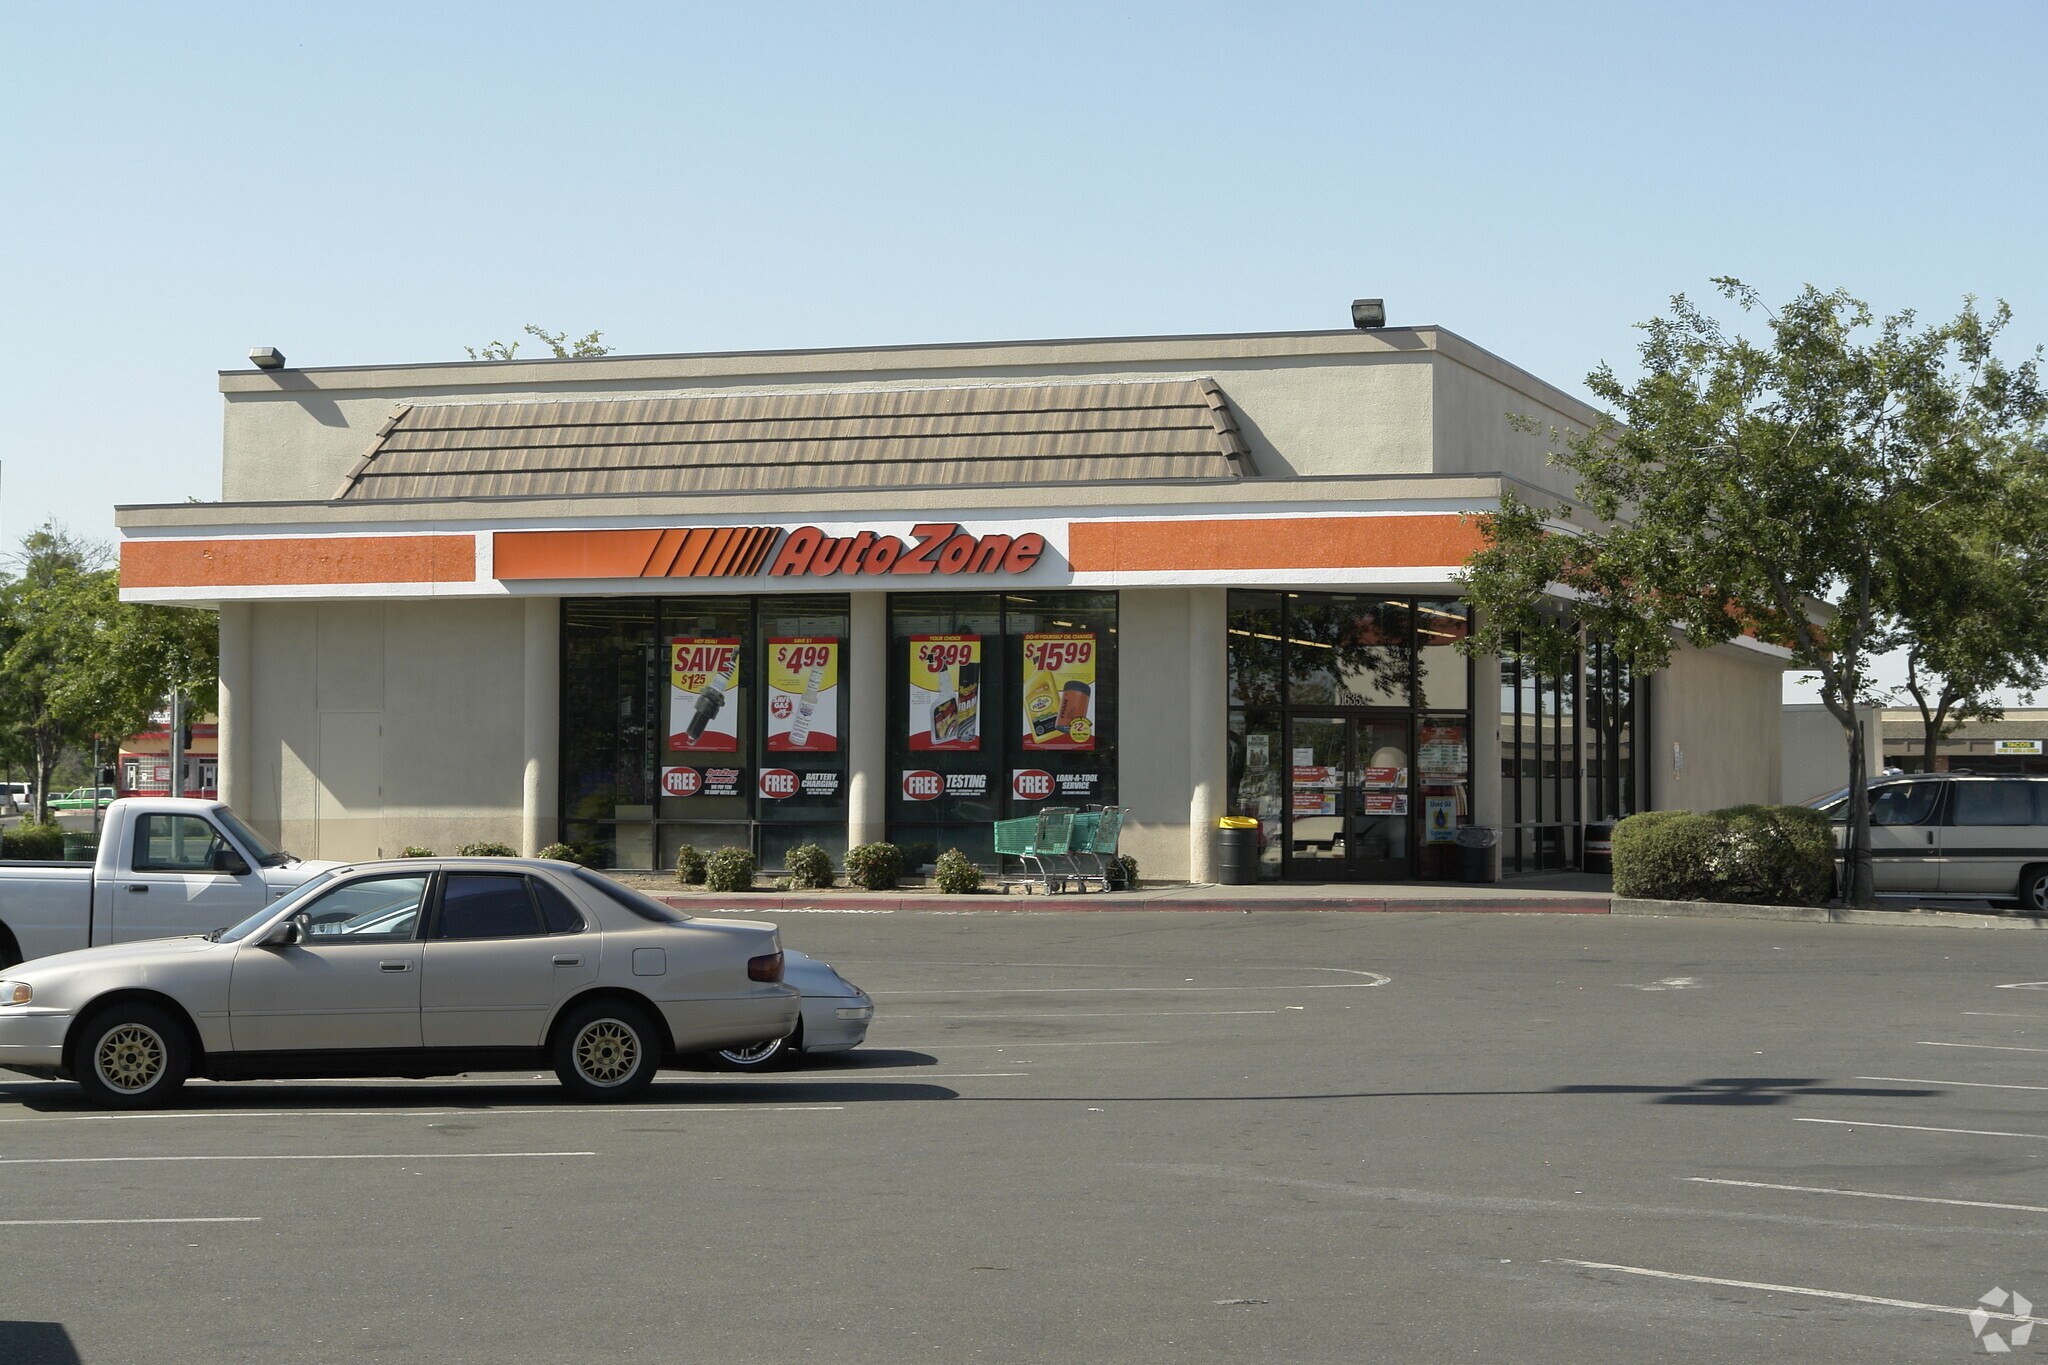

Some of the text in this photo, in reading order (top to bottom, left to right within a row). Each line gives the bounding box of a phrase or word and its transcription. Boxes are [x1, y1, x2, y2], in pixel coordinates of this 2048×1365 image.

[769, 523, 1046, 576] AutoZone
[674, 646, 734, 672] SAVE
[667, 772, 696, 790] FREE
[765, 774, 794, 792] FREE
[801, 780, 839, 788] CHARGING
[805, 773, 837, 781] BATTERY
[908, 776, 939, 794] FREE
[945, 774, 987, 788] TESTING
[1019, 775, 1050, 794] FREE
[1056, 774, 1098, 782] LOAN-A-TOOL
[1061, 781, 1090, 790] SERVICE
[1430, 800, 1452, 808] Used Oil
